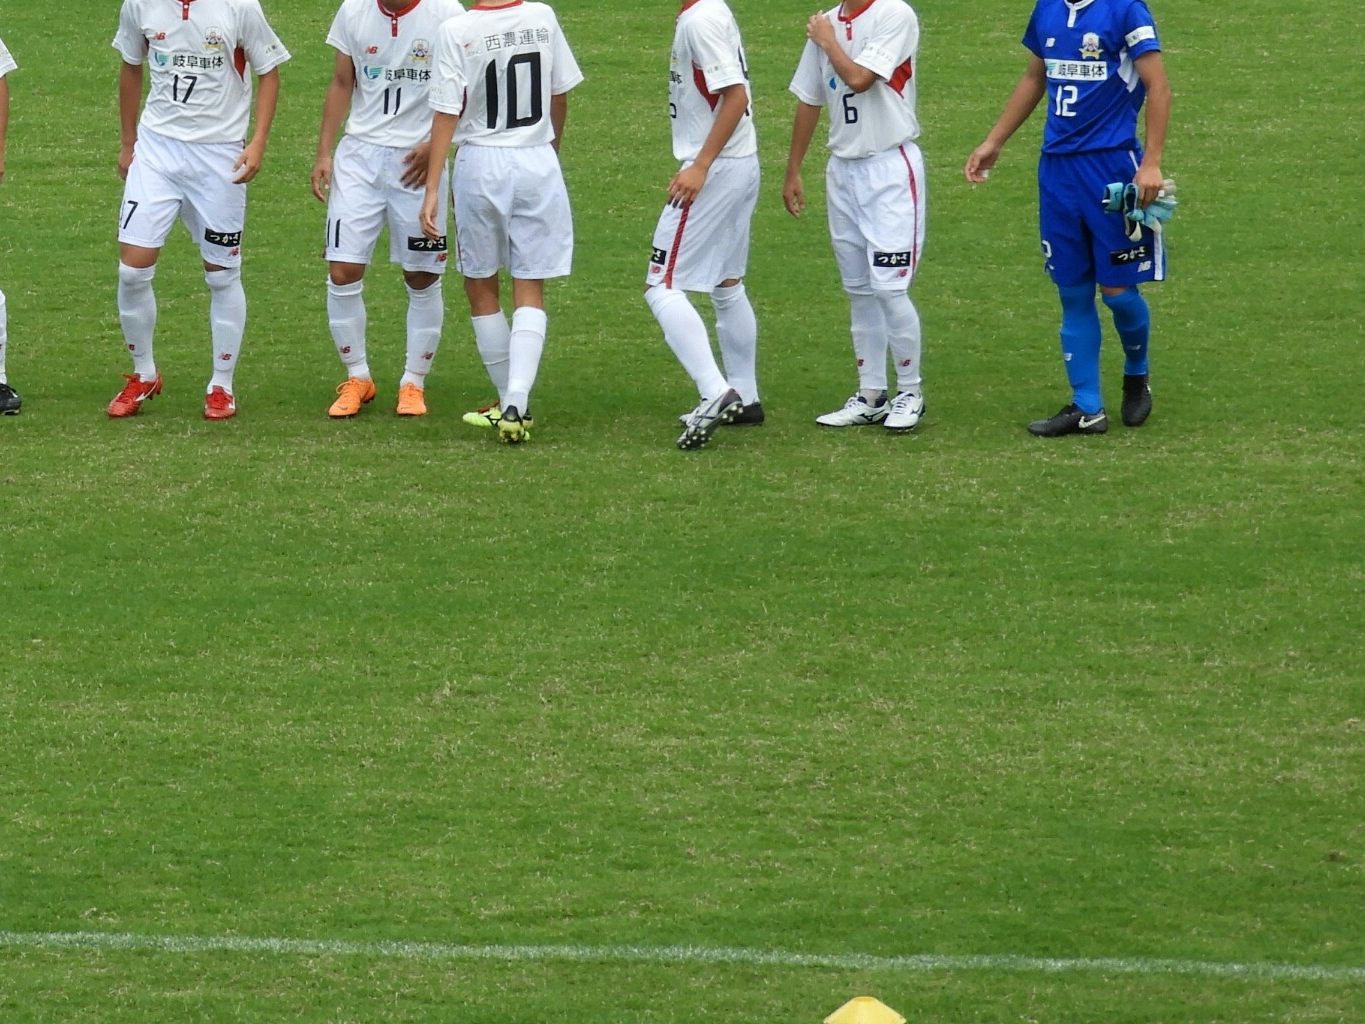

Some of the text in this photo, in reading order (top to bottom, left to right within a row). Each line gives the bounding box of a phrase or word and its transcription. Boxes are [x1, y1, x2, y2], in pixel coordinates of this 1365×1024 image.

[484, 28, 550, 52] 西濃運輸
[172, 53, 224, 69] 岐阜車体
[1059, 64, 1106, 78] 岐阜車体
[173, 74, 198, 103] 17
[485, 51, 543, 129] 10
[1056, 85, 1078, 117] 12
[383, 88, 401, 115] 11
[843, 93, 858, 124] 6
[120, 200, 139, 230] 7
[414, 238, 445, 249] つかさ
[1117, 247, 1145, 260] つかさ
[878, 254, 907, 265] つかさ
